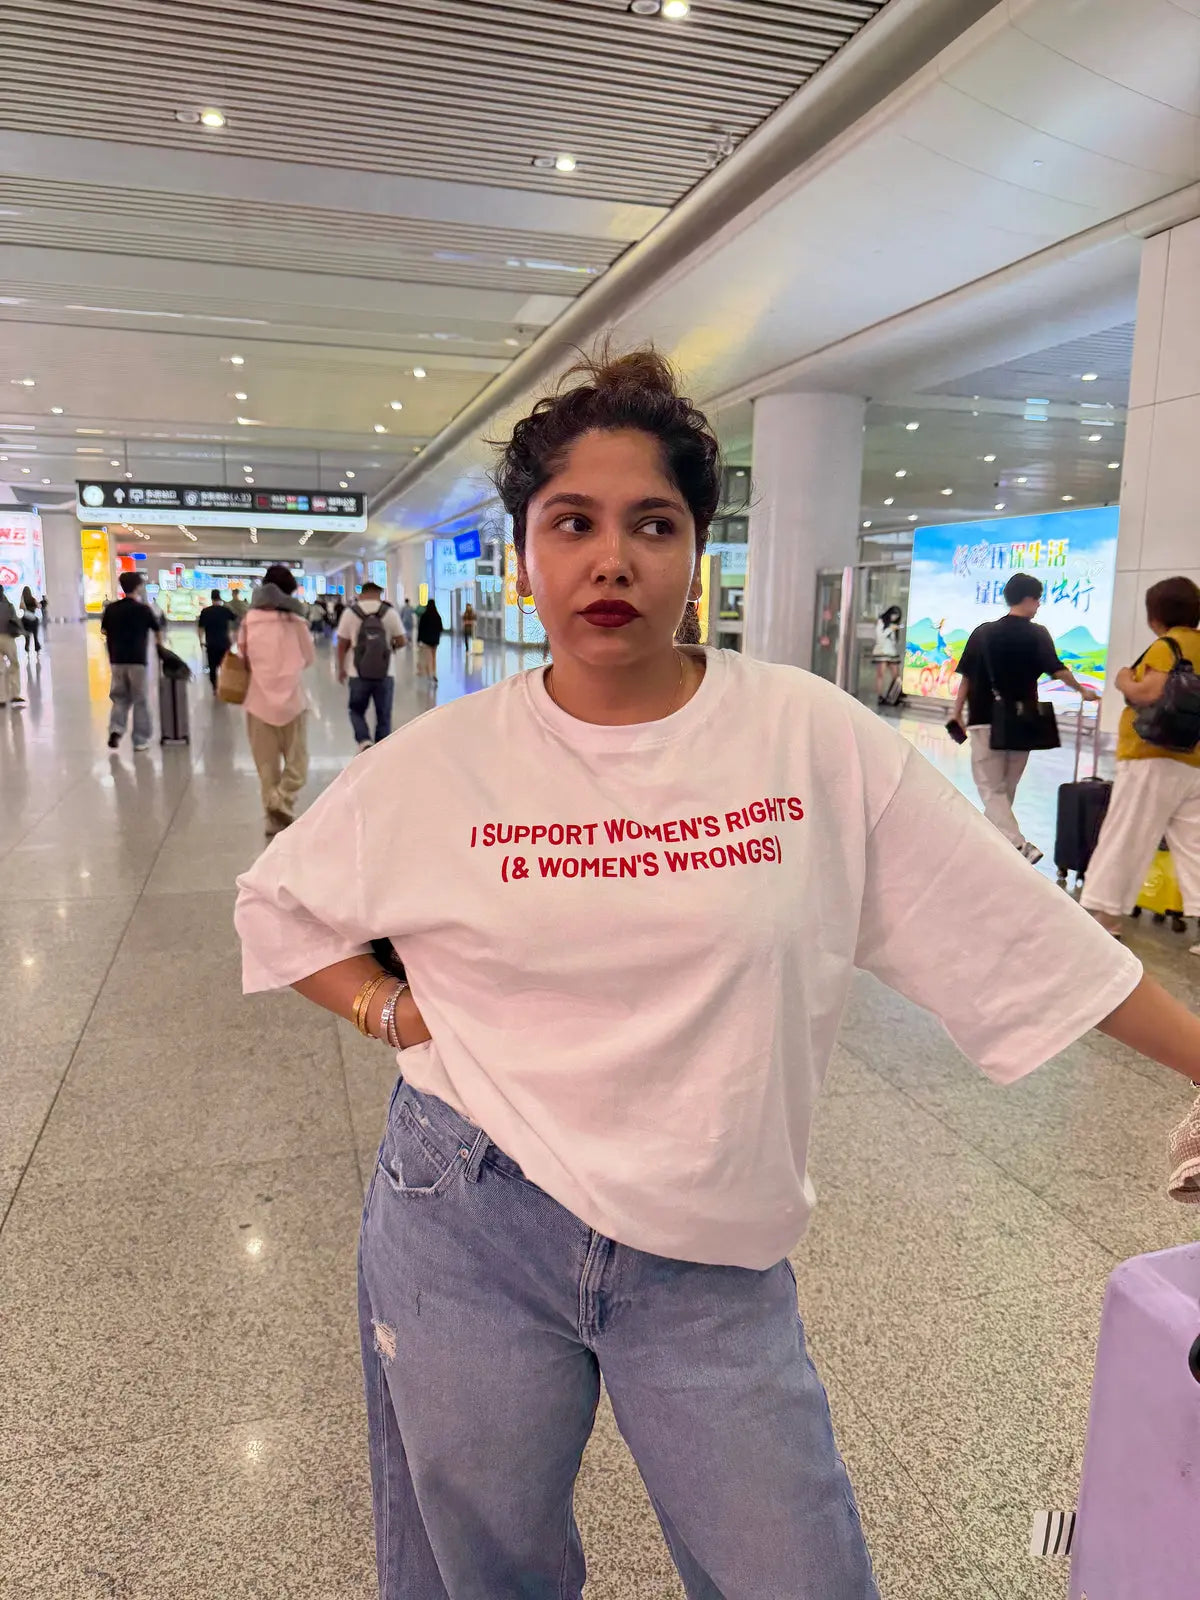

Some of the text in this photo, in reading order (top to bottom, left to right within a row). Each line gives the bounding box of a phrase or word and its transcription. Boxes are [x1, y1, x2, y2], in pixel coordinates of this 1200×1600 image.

[975, 573, 1096, 613] 绿色出行
[471, 797, 804, 848] I SUPPORT WOMEN'S RIGHTS
[501, 836, 782, 884] (& WOMEN'S WRONGS)
